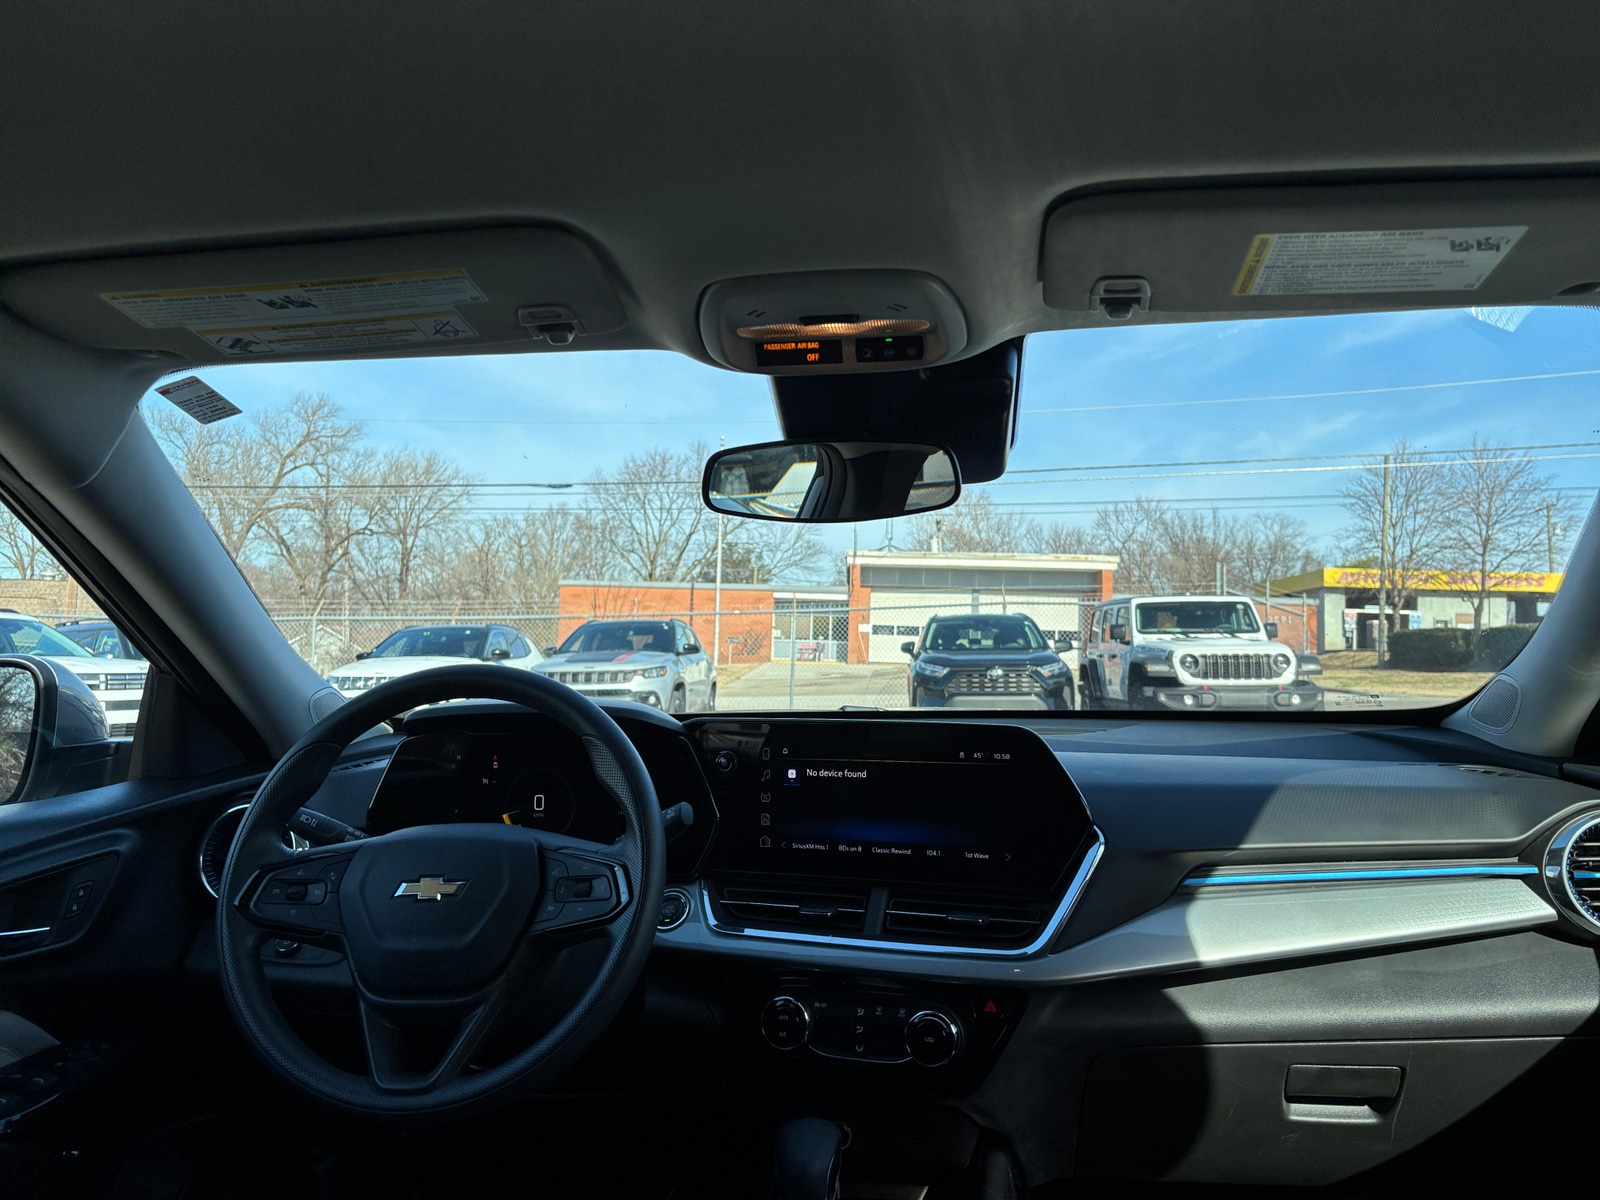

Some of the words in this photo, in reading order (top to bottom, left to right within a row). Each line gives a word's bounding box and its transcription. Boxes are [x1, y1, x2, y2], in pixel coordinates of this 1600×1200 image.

[797, 342, 807, 350] AIR
[806, 353, 820, 362] OFF
[806, 768, 818, 777] No
[818, 769, 843, 778] device
[844, 770, 867, 778] found
[534, 794, 544, 811] 0
[792, 842, 814, 850] SiriusXM
[872, 846, 890, 854] Classic
[974, 852, 990, 860] Wave
